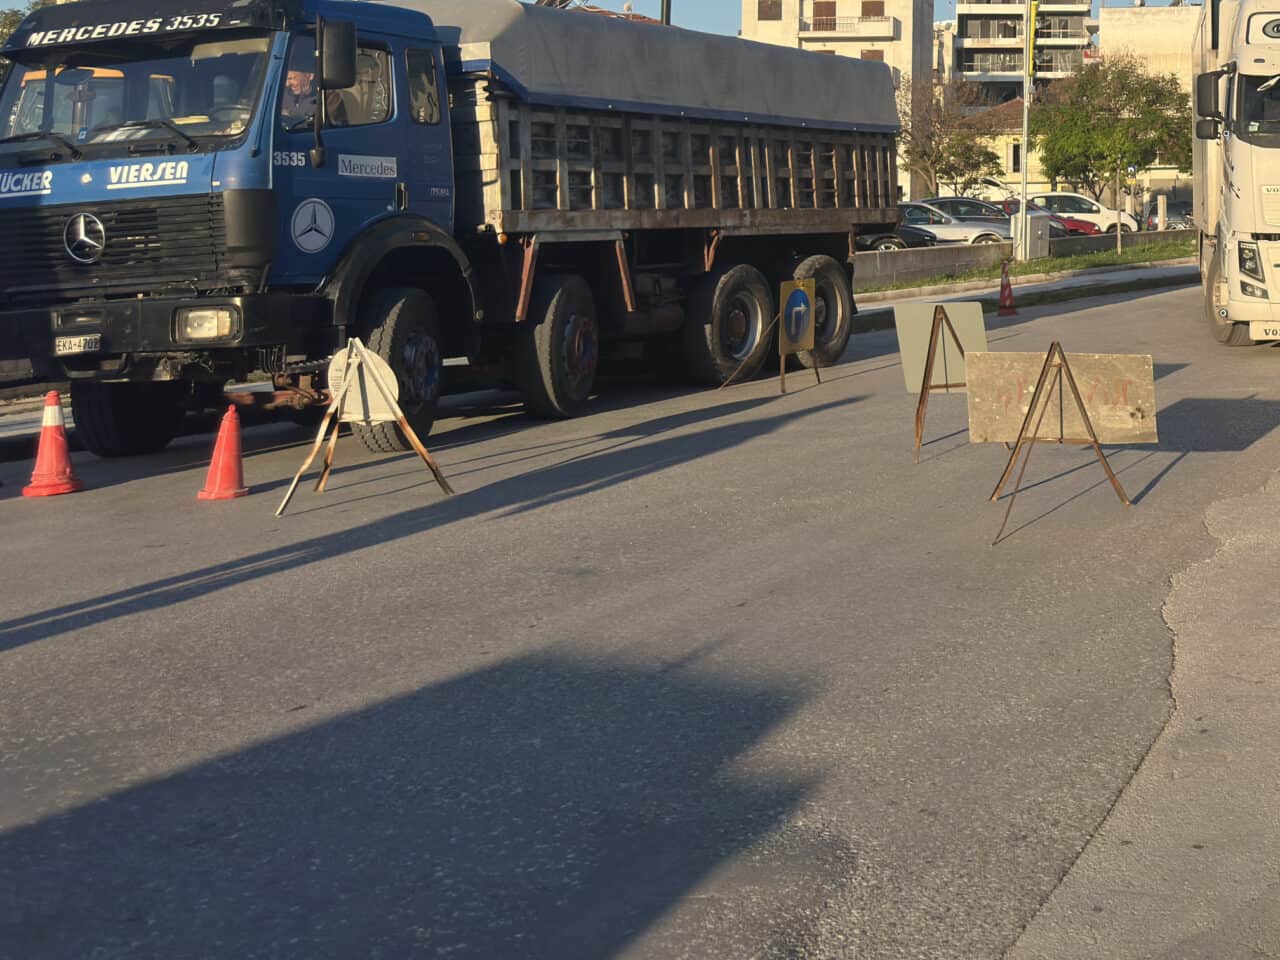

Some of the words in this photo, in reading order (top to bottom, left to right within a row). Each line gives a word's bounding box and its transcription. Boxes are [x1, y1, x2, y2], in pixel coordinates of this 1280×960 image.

[26, 17, 163, 47] MERCEDES
[165, 13, 223, 31] 3535
[273, 151, 306, 167] 3535
[340, 158, 396, 177] Mercedes
[0, 170, 53, 193] ÜCKER
[110, 161, 189, 184] VIERSEN
